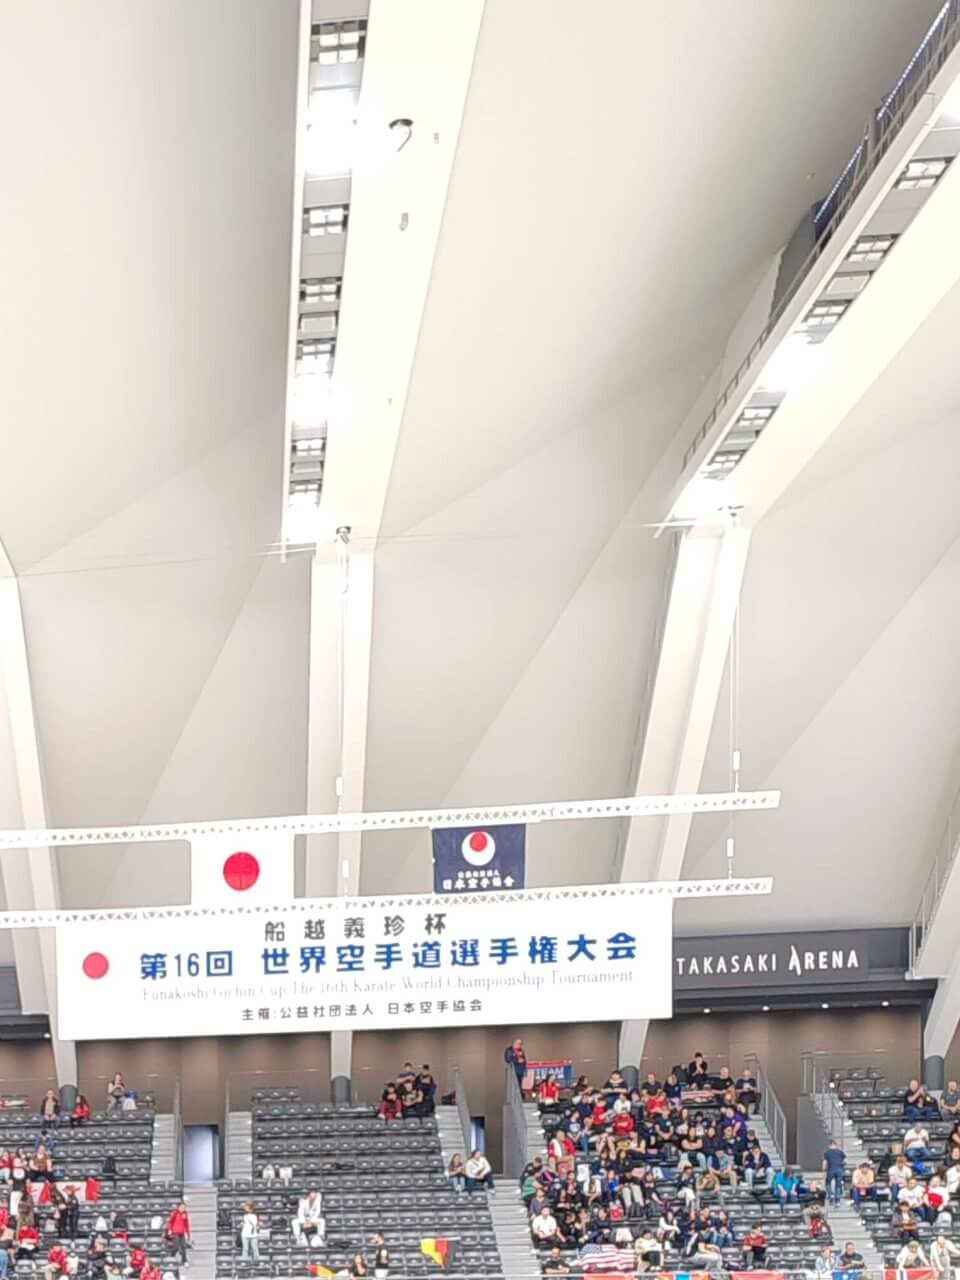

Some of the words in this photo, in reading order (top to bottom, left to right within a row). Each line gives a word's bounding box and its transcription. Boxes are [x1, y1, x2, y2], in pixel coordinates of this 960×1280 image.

[139, 950, 234, 980] 第16回
[261, 931, 638, 976] 世界空手道選手権大会
[675, 953, 777, 976] TAKASAKI
[788, 945, 860, 976] ARENA
[353, 975, 397, 993] Karate
[401, 972, 443, 991] World
[447, 970, 545, 991] Championship
[551, 967, 634, 985] Tournament
